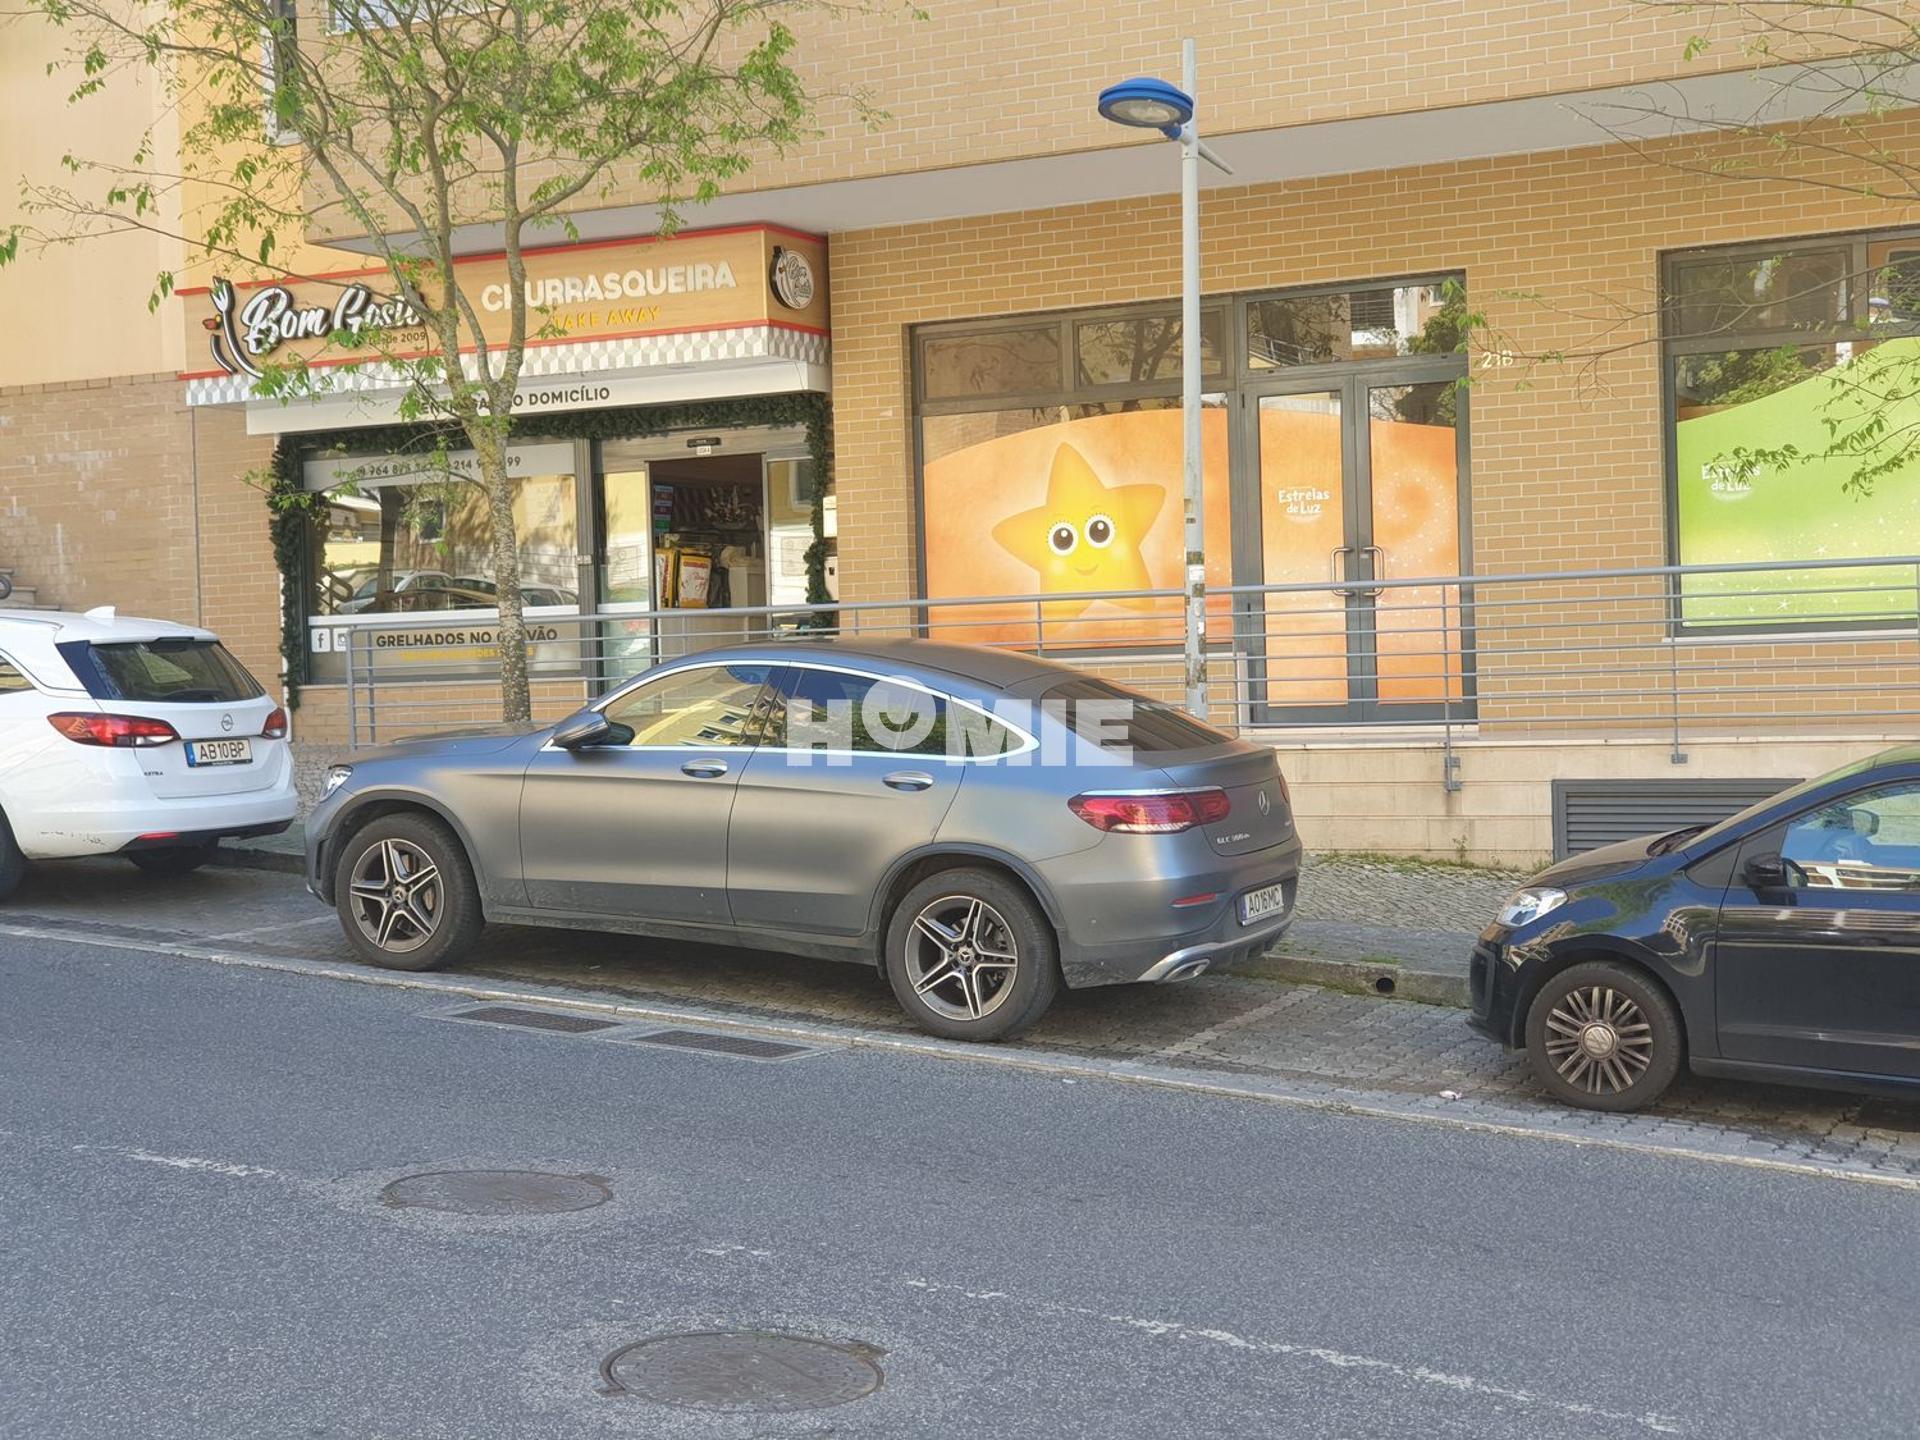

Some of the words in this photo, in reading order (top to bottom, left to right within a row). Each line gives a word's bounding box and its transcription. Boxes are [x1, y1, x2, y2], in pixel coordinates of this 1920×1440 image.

[241, 287, 330, 354] Bom
[606, 305, 660, 326] AWAY
[401, 331, 426, 342] 2009
[529, 385, 610, 406] DOMICÍLIO
[454, 459, 472, 470] 214
[1278, 488, 1330, 504] Estrelas
[1286, 502, 1299, 513] de
[1301, 501, 1321, 514] Luz
[376, 632, 465, 647] GRELHADOS
[470, 631, 492, 643] NO
